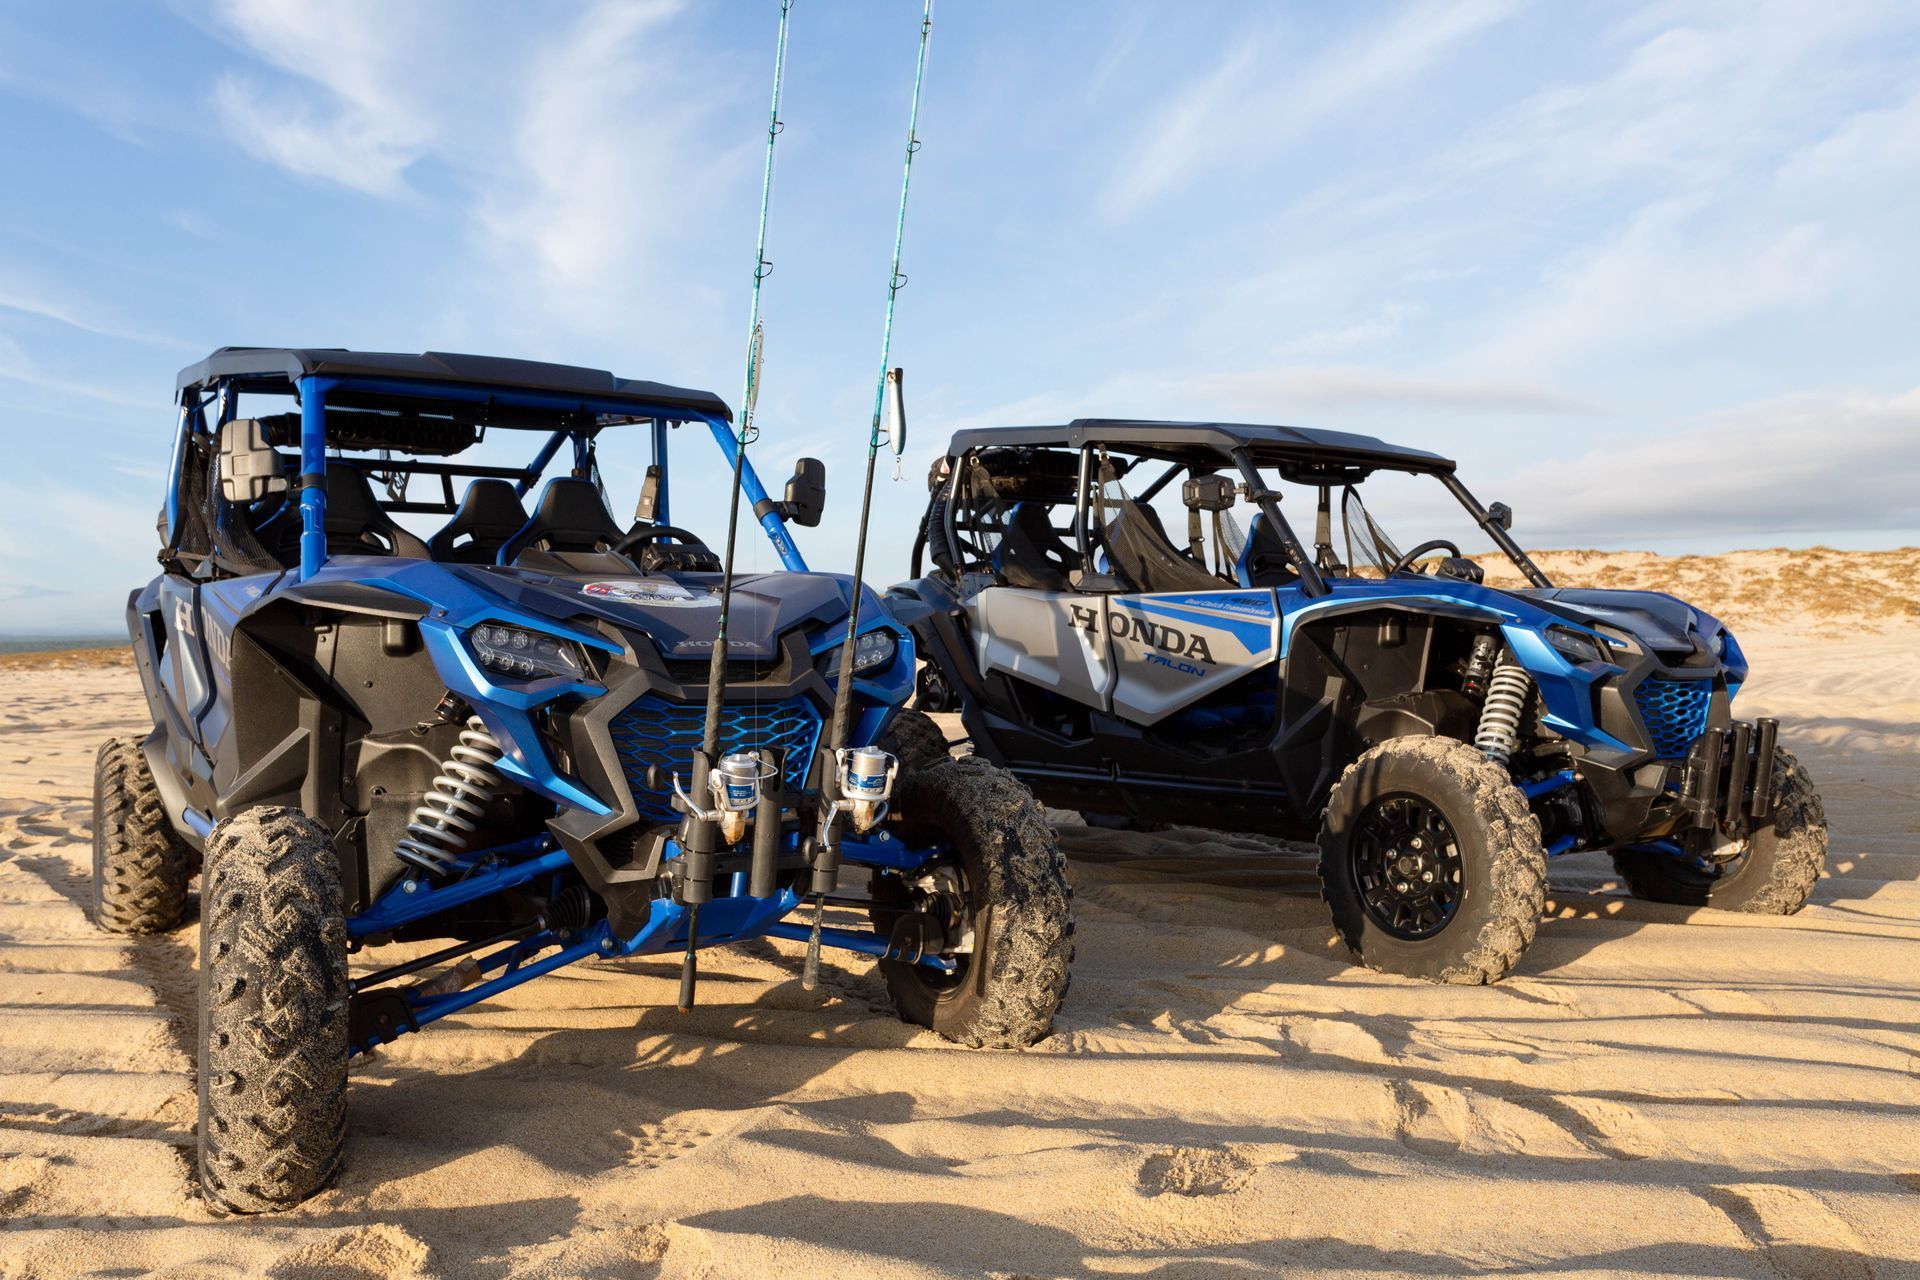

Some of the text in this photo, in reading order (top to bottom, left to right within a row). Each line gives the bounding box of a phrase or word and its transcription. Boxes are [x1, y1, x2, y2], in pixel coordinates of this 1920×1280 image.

[1200, 600, 1224, 609] Clutch
[1223, 603, 1271, 615] Transmission
[1068, 604, 1216, 665] HONDA
[1144, 653, 1206, 677] TALON
